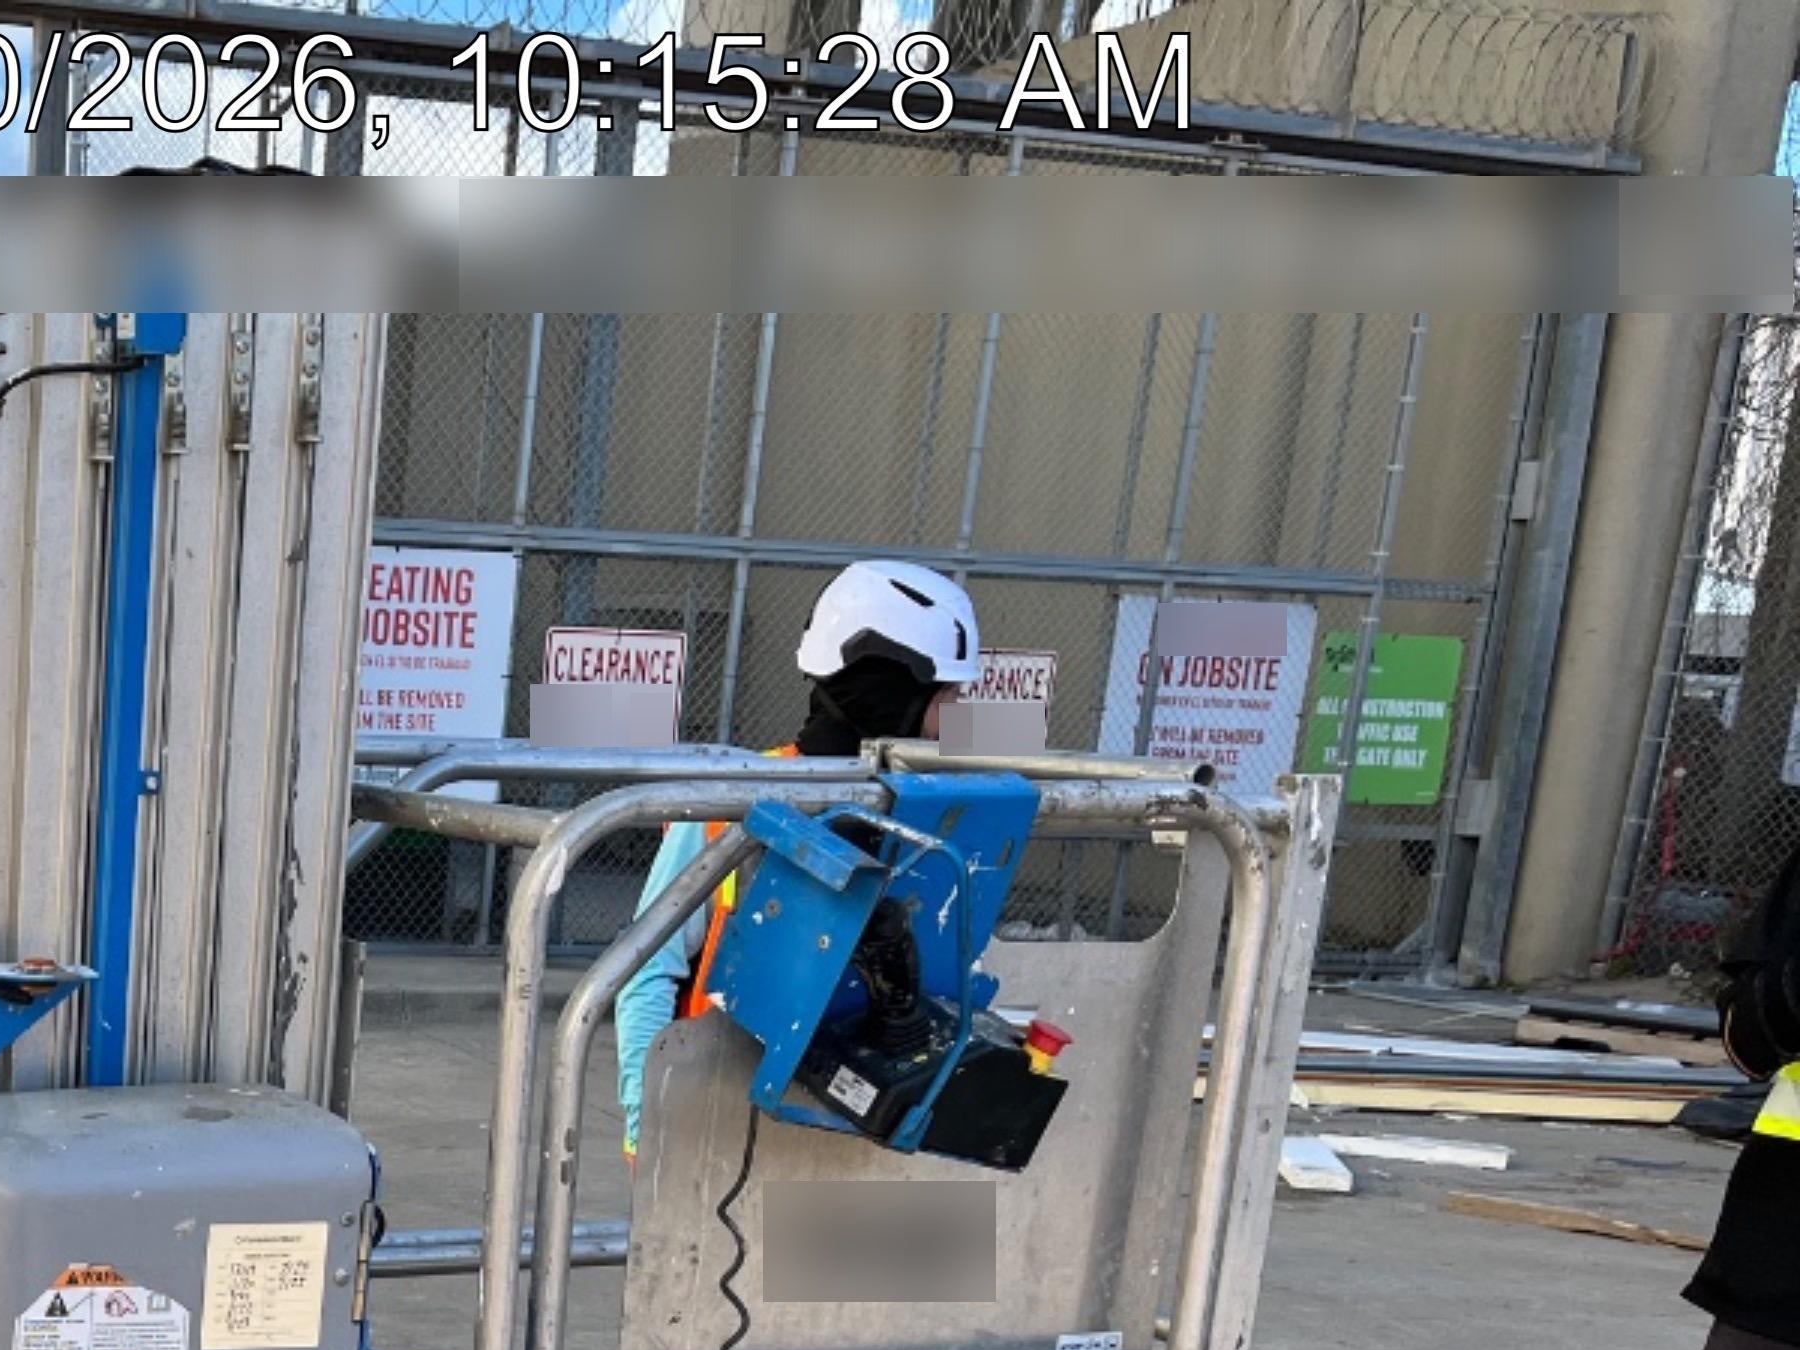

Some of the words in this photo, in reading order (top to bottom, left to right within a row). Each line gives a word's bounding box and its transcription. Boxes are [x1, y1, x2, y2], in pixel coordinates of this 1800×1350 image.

[368, 563, 474, 606] EATING
[554, 645, 675, 684] CLEARANCE
[1177, 655, 1281, 690] JOBSITE
[399, 690, 465, 709] REMOVED
[378, 711, 402, 730] THE
[407, 713, 437, 732] SITE
